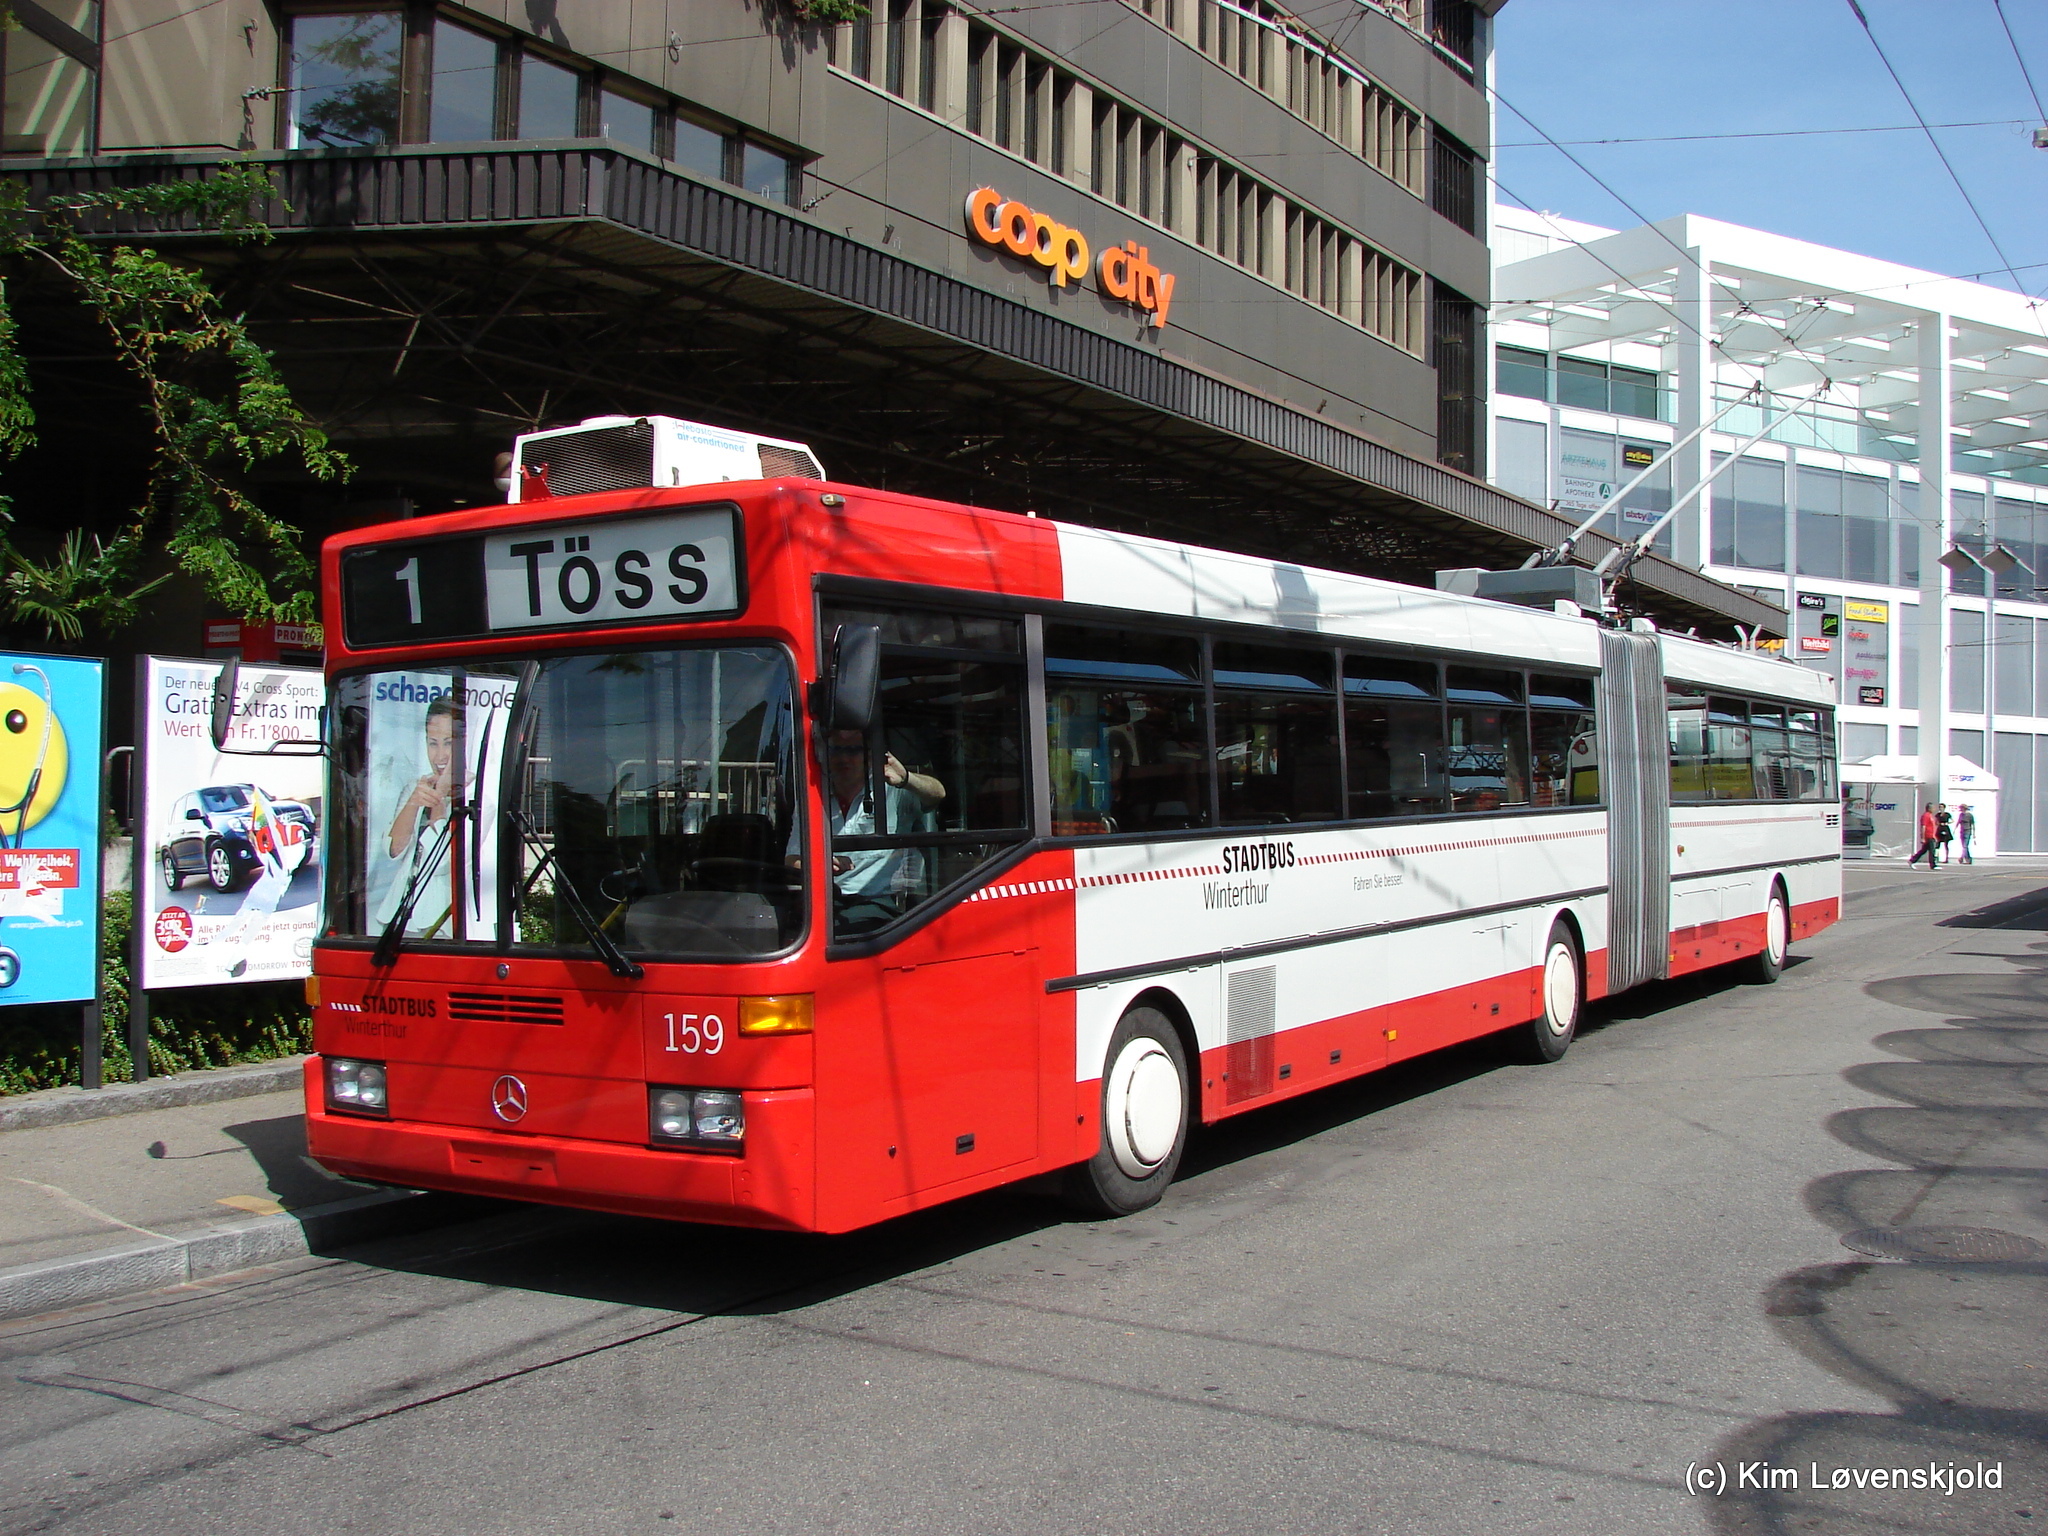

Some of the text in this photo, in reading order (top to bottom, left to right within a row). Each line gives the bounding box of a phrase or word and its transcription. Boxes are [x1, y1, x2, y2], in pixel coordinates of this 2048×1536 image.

[965, 188, 1175, 328] coop city
[677, 432, 745, 453] air-conditioned
[1565, 479, 1595, 488] BAHNHOF
[1565, 488, 1595, 498] APOTHEKE
[395, 536, 709, 625] 1 TÖSS
[1801, 596, 1824, 606] claire's
[1802, 638, 1830, 649] Weltbild
[165, 676, 186, 689] Der
[189, 680, 216, 691] neue
[253, 682, 283, 695] Cross
[286, 683, 319, 699] Sport:
[165, 692, 217, 715] Grati
[295, 700, 317, 720] im
[164, 720, 202, 738] Wert
[1223, 841, 1296, 874] STADTBUS
[1353, 873, 1403, 891] Fahren Sie besser.
[1202, 877, 1270, 910] Winterthur
[198, 925, 213, 933] Alle
[272, 923, 290, 933] jetzt
[291, 960, 311, 968] TOYO
[361, 994, 437, 1018] STADTBUS
[344, 1015, 408, 1039] Winterthur
[663, 1013, 725, 1055] 159
